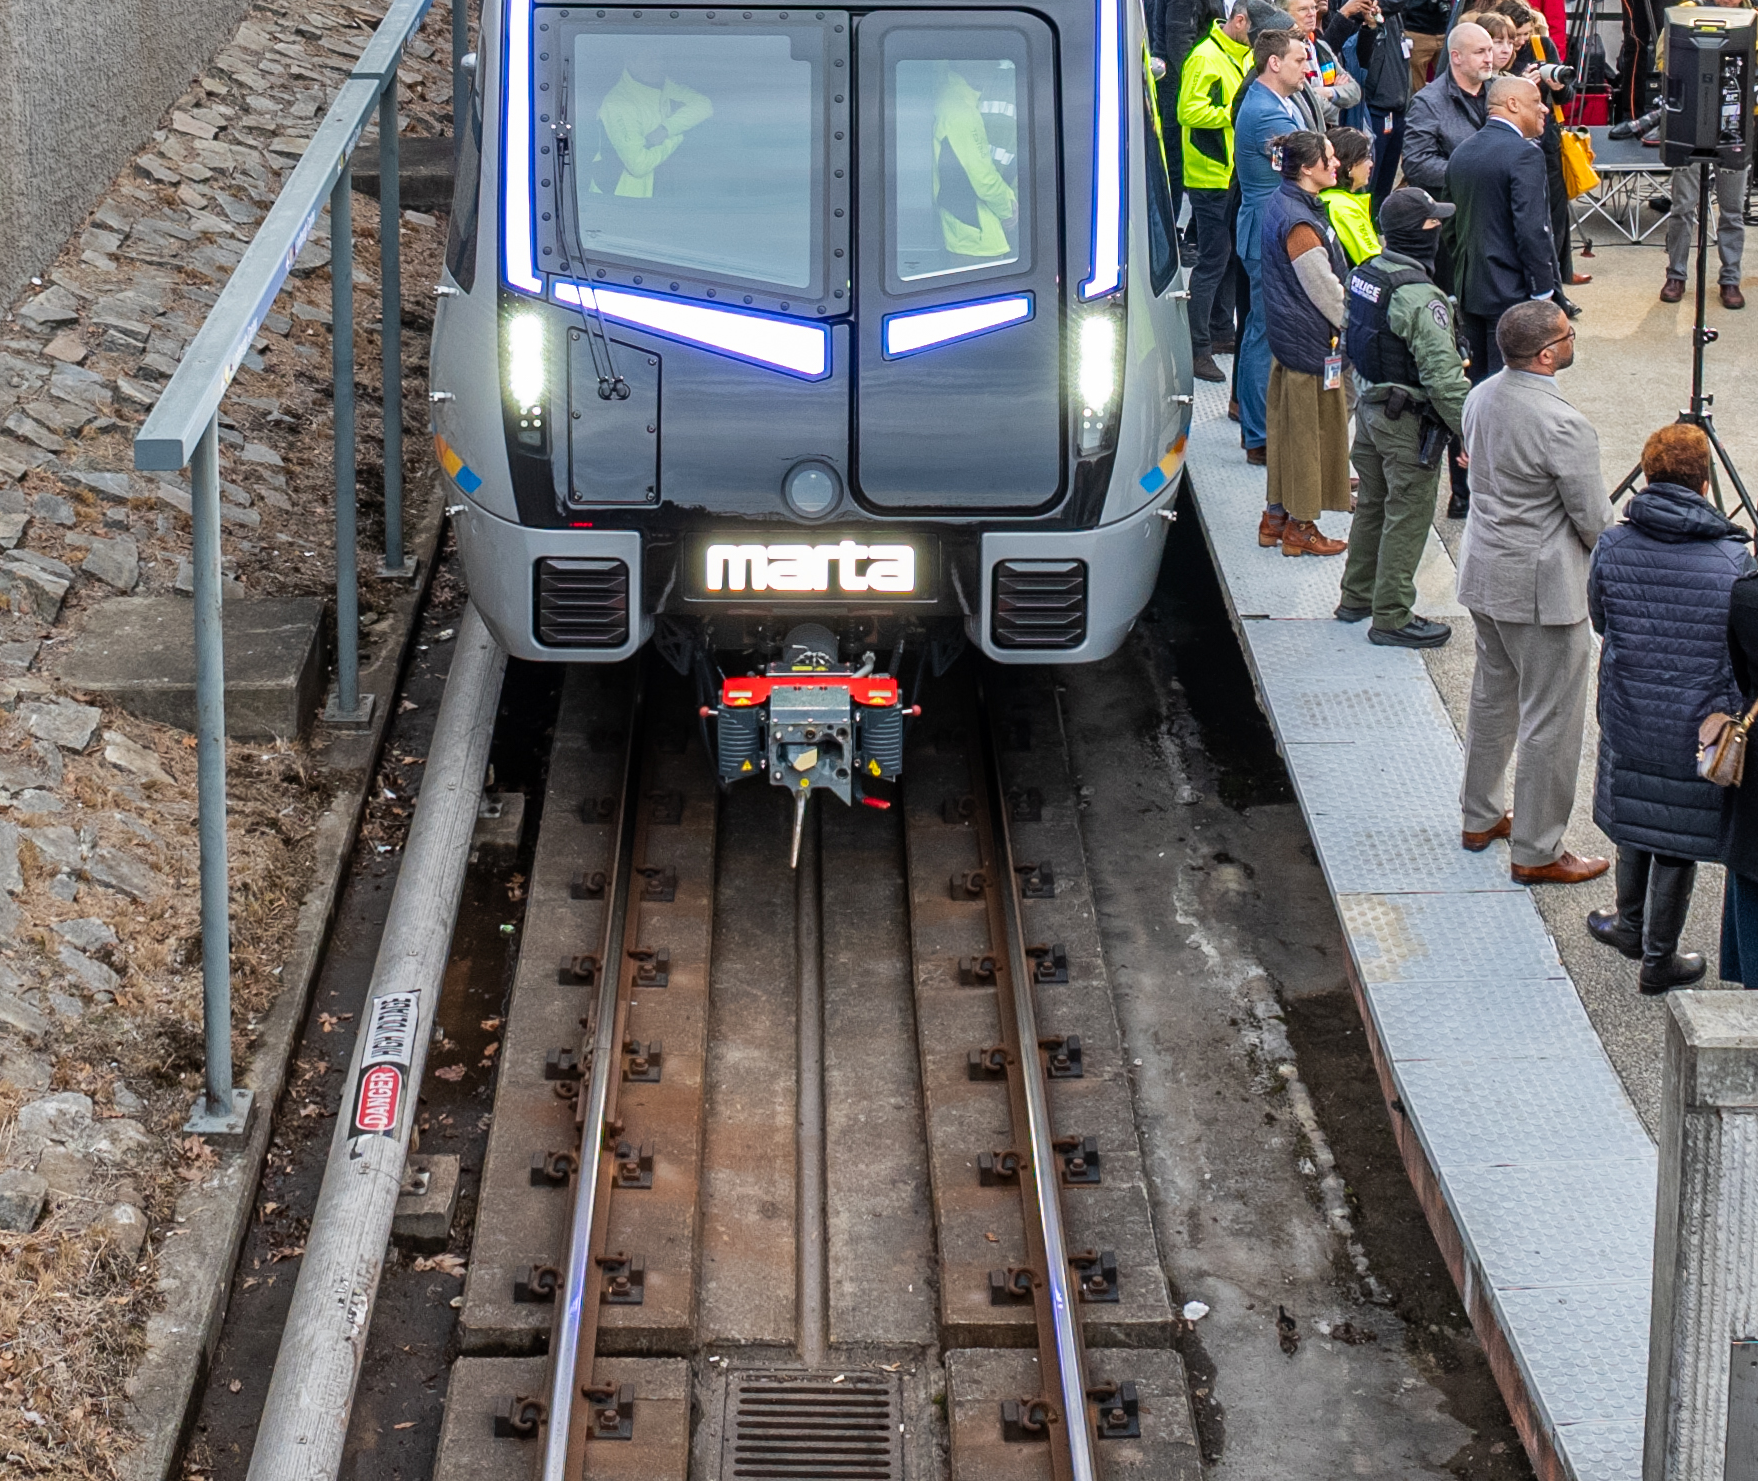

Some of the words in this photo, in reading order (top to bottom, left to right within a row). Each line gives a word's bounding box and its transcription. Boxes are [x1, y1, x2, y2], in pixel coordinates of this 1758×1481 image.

[1351, 275, 1382, 298] POLICE
[706, 539, 915, 592] marta
[374, 997, 412, 1036] VOLTAGE
[370, 1035, 406, 1058] HIGH
[363, 1071, 396, 1126] DANGER
